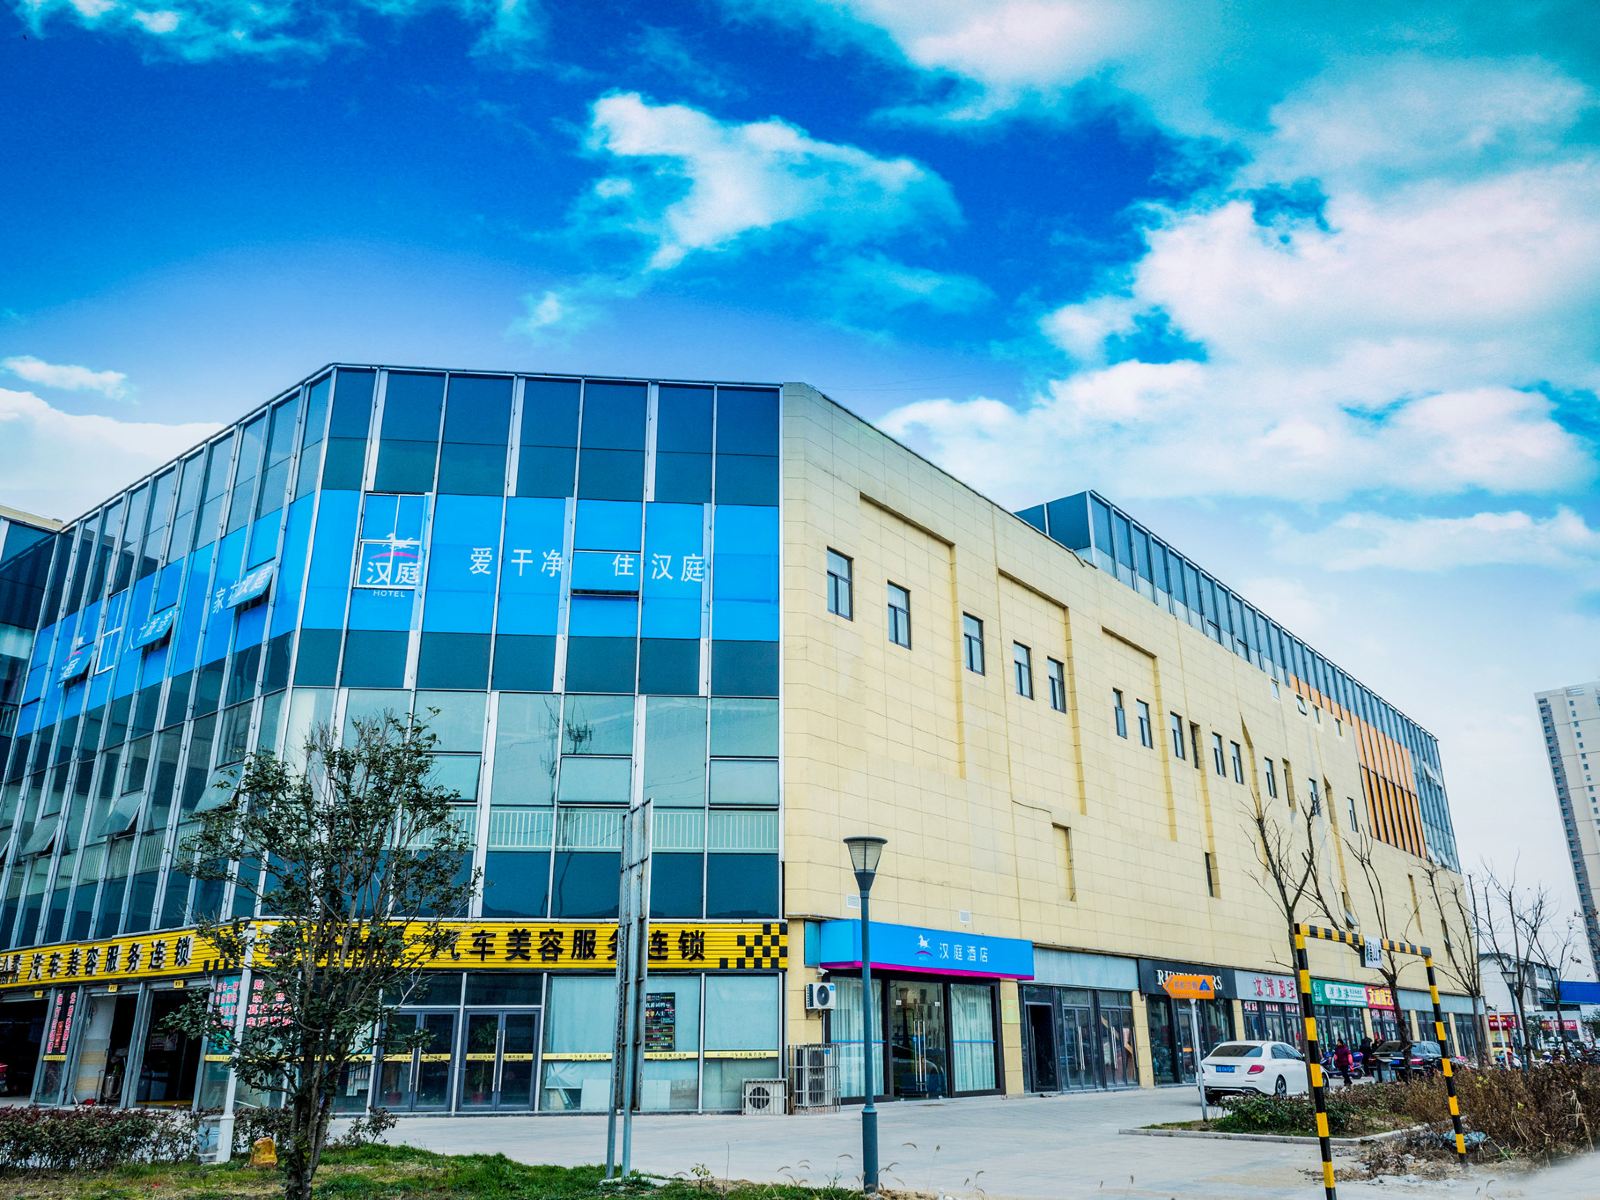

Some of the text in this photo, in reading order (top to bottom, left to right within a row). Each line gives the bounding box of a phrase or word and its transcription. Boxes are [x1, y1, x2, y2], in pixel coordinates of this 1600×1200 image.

[366, 561, 421, 585] 汉庭
[470, 547, 706, 582] 爱干净 住汉庭
[372, 590, 406, 598] HOTEL
[28, 935, 194, 981] 汽车美容服务连锁
[939, 942, 989, 963] 汉庭酒店
